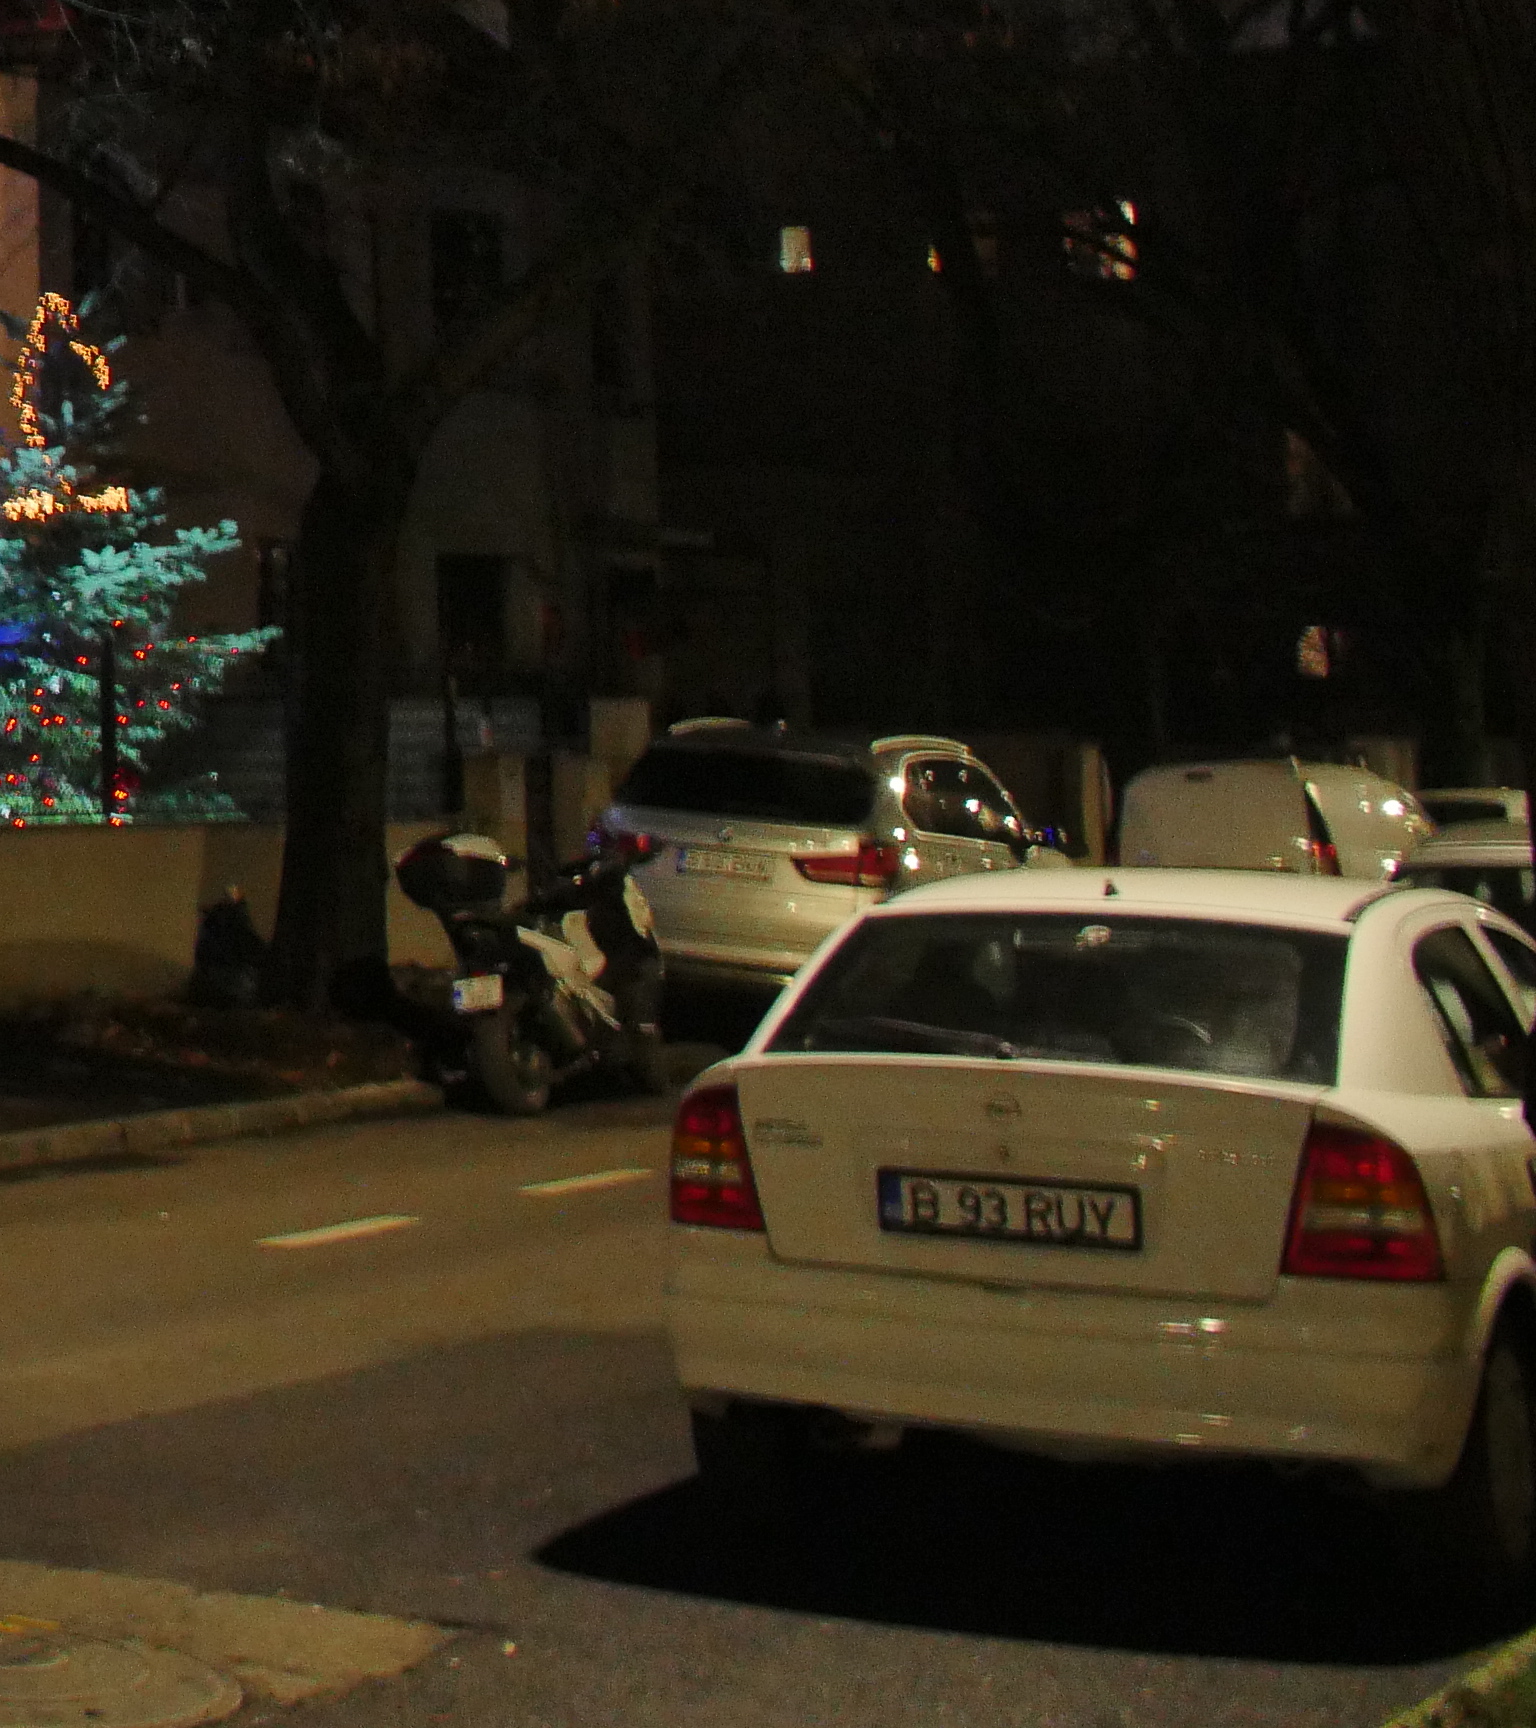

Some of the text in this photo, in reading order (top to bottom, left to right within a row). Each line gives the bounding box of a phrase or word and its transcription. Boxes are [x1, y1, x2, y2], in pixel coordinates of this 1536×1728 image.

[906, 1180, 1116, 1238] B 93 RUY
